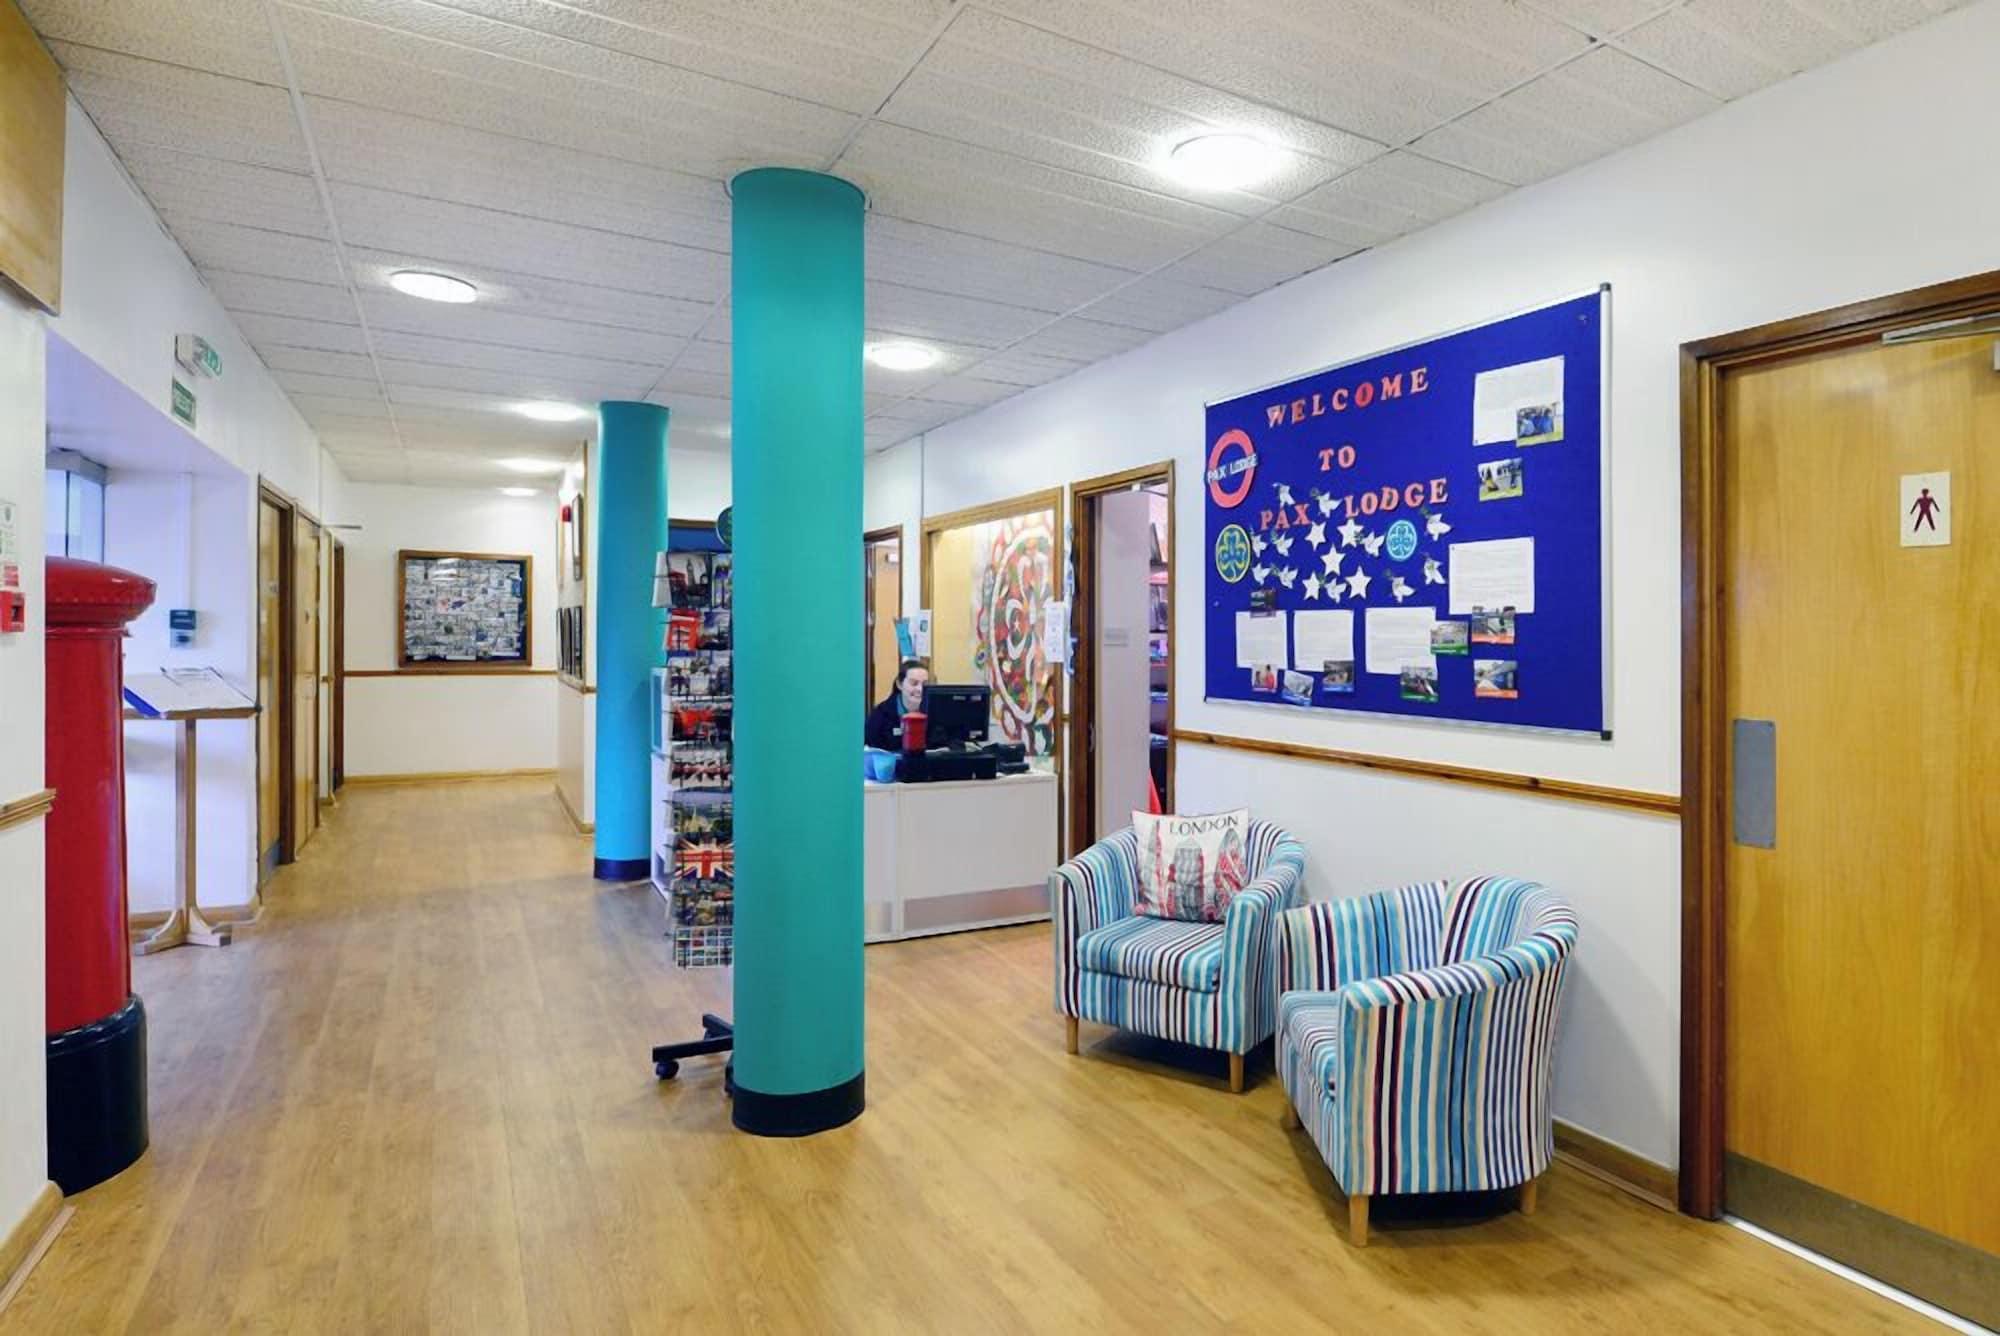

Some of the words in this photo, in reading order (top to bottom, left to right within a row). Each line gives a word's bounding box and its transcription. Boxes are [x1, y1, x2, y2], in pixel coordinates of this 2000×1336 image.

[1266, 367, 1428, 428] WELCOME
[1207, 464, 1226, 484] PAX
[1229, 453, 1258, 475] LODGE
[1319, 445, 1356, 471] TO
[1260, 503, 1312, 531] PAX
[1344, 478, 1449, 518] LODGE
[1169, 815, 1239, 835] LONDON
